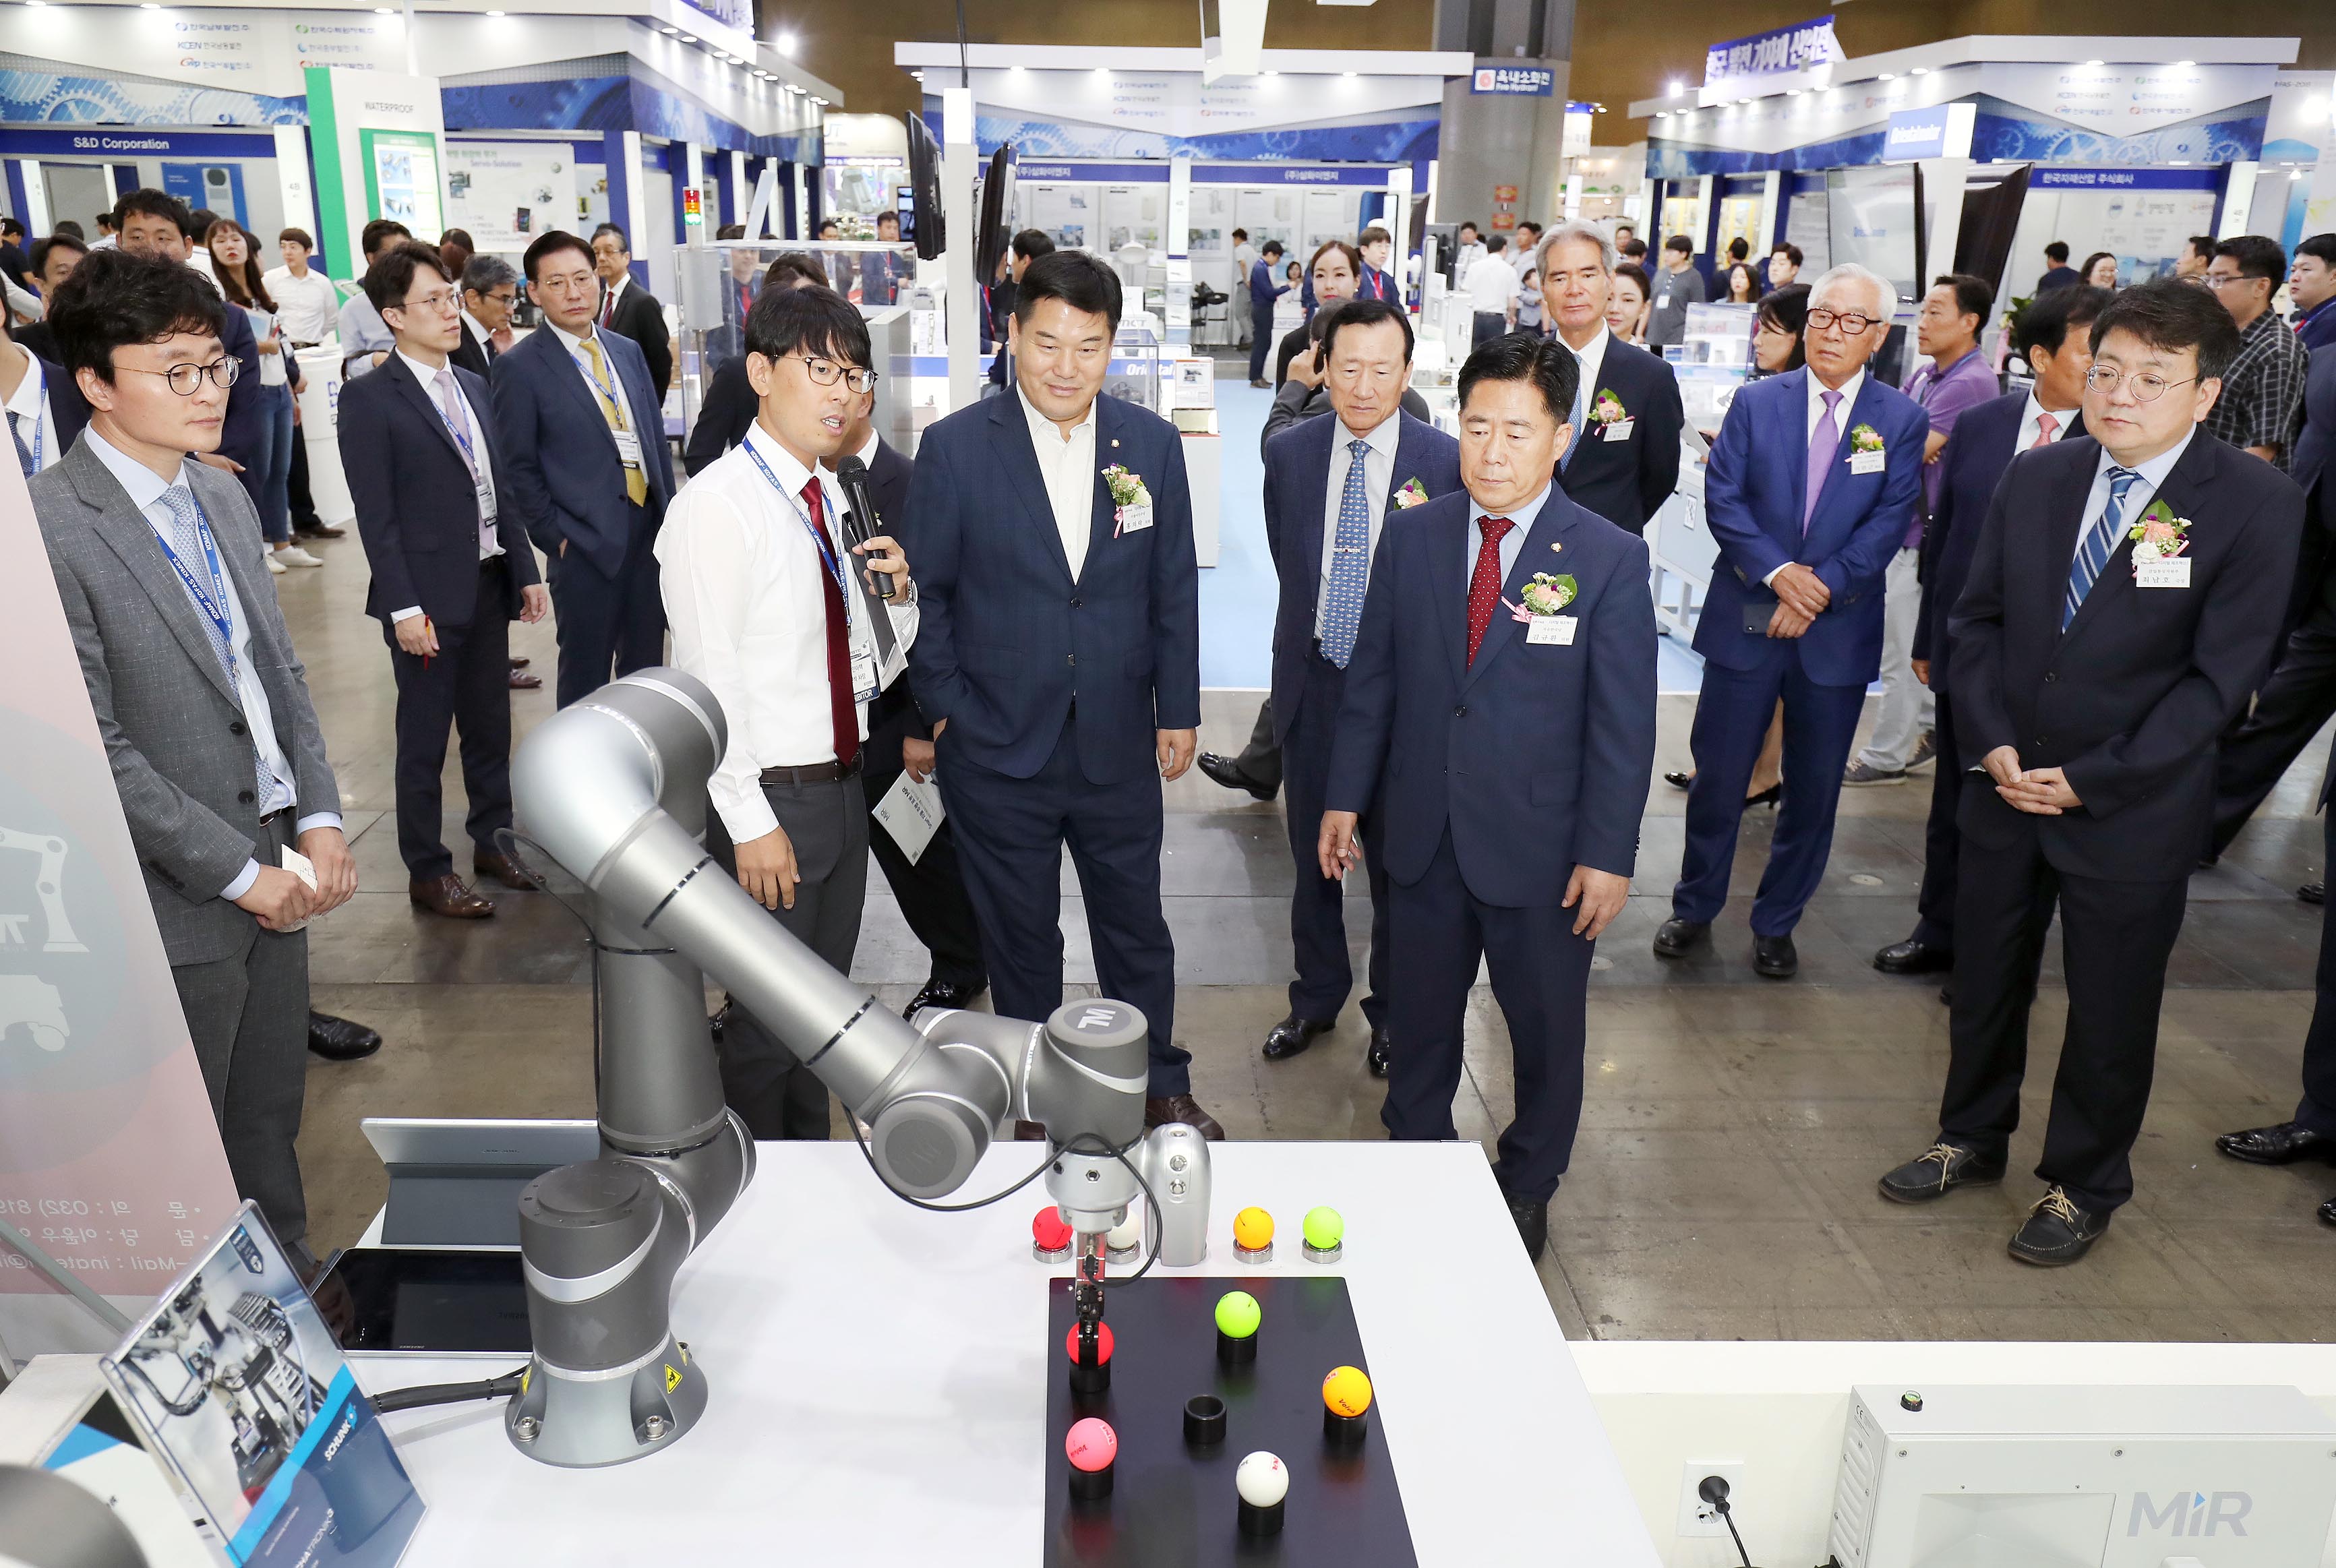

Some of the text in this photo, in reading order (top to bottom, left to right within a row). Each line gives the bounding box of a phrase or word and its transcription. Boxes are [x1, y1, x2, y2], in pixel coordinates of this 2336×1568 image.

[365, 102, 413, 113] WATERPROOF
[73, 137, 170, 150] S&D Corporation
[324, 1419, 351, 1461] SCHUNK
[2126, 1491, 2253, 1537] MiR
